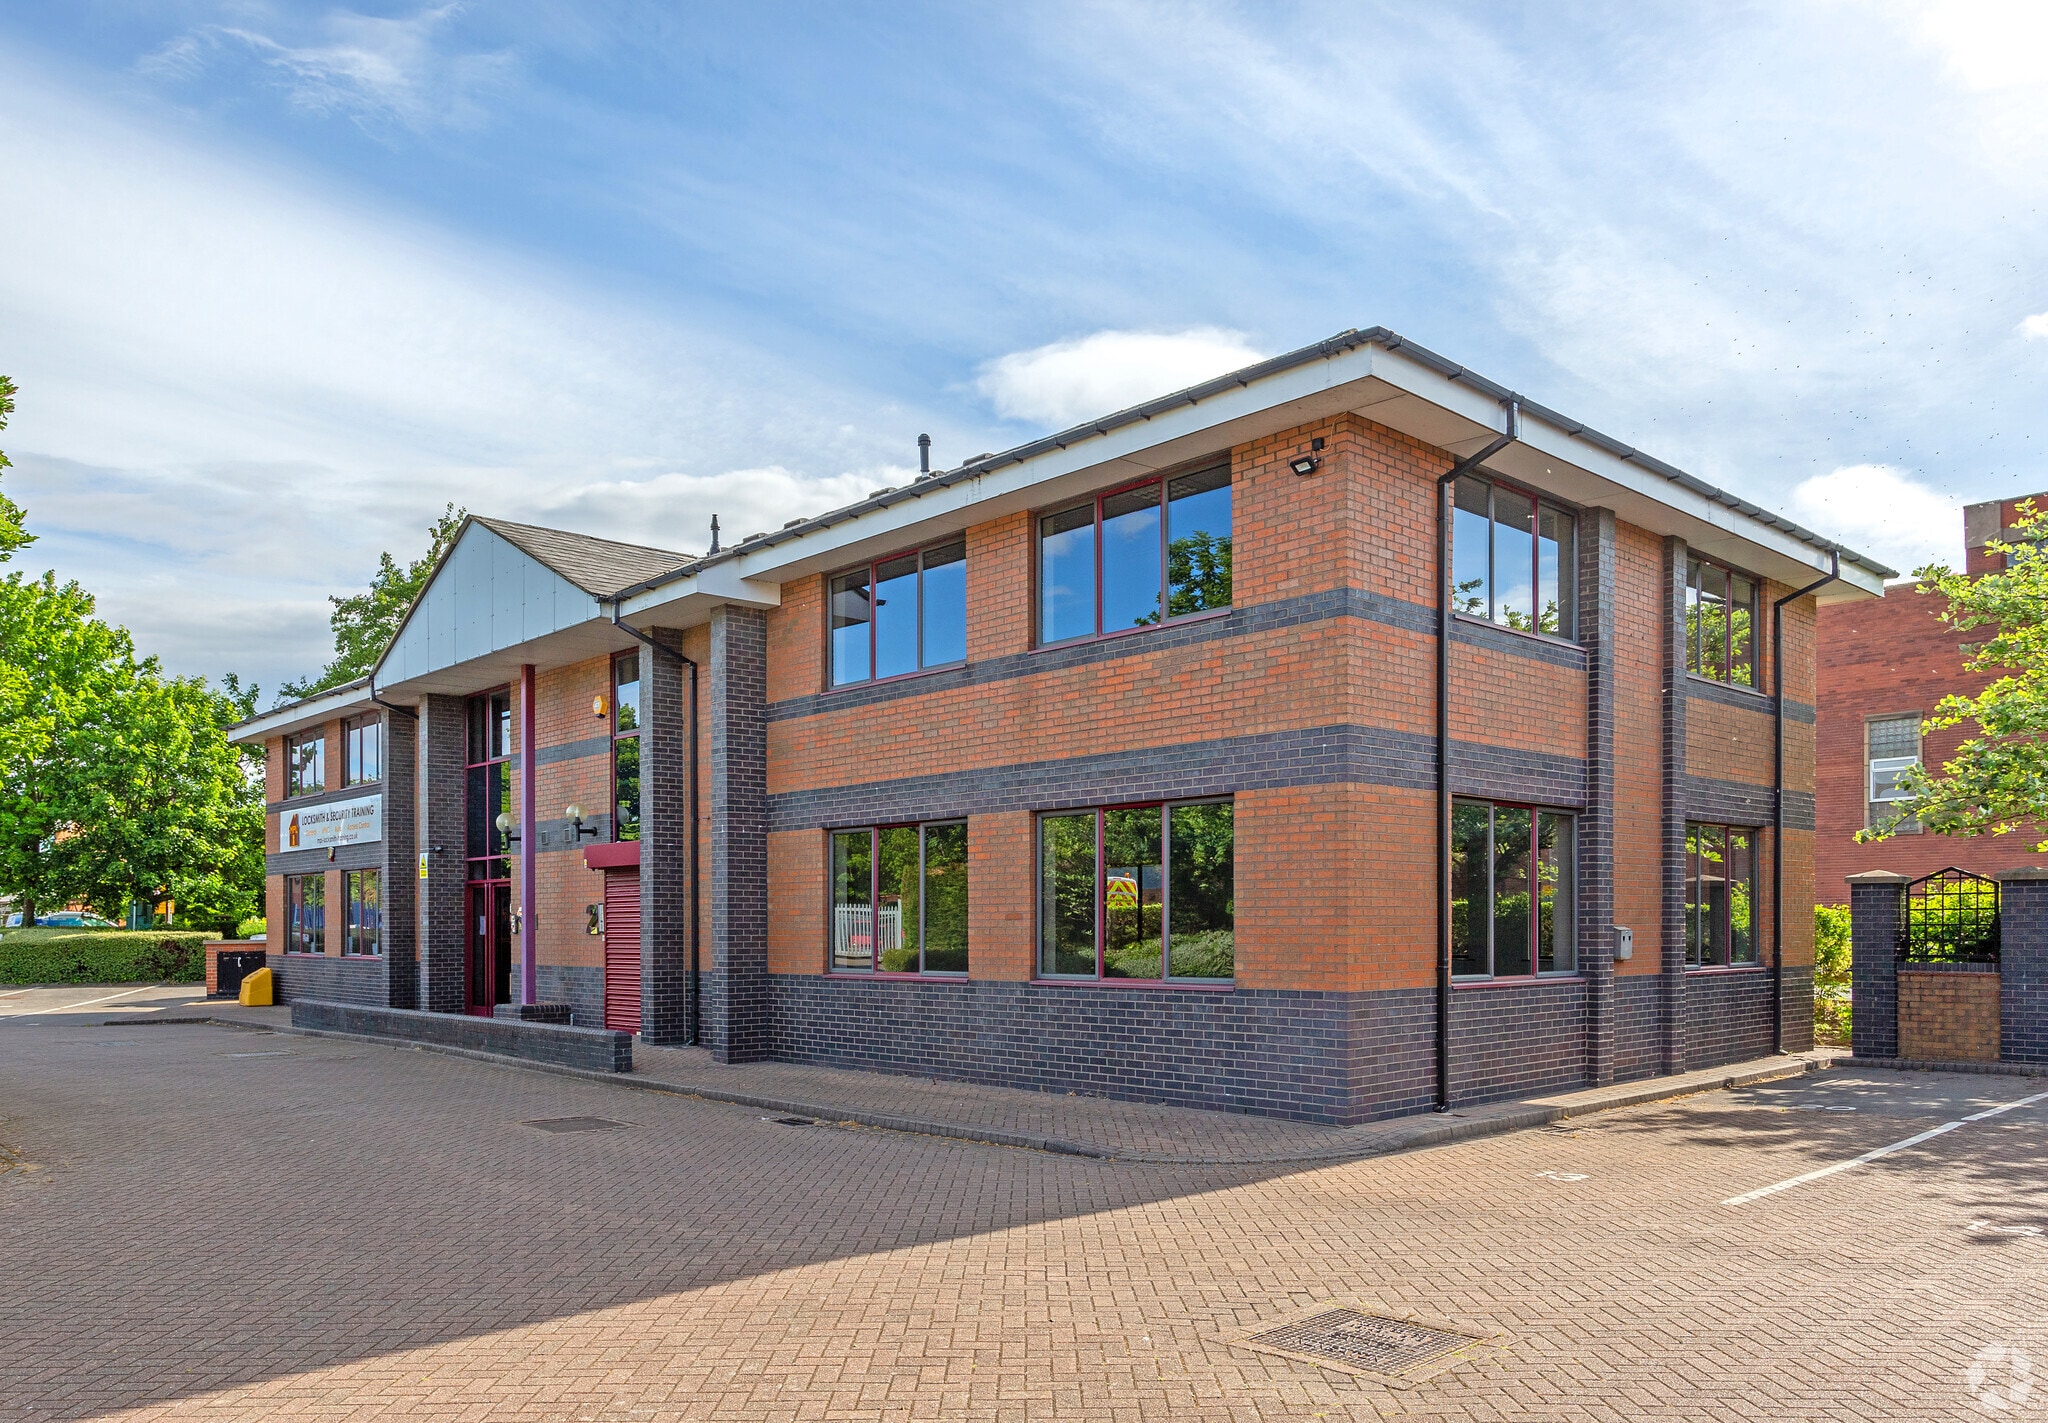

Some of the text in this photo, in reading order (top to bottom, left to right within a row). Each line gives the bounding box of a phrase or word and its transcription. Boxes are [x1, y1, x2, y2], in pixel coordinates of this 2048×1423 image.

[301, 805, 375, 826] LOCKSMITH & SECURITY TRAINING
[585, 904, 599, 935] 2
